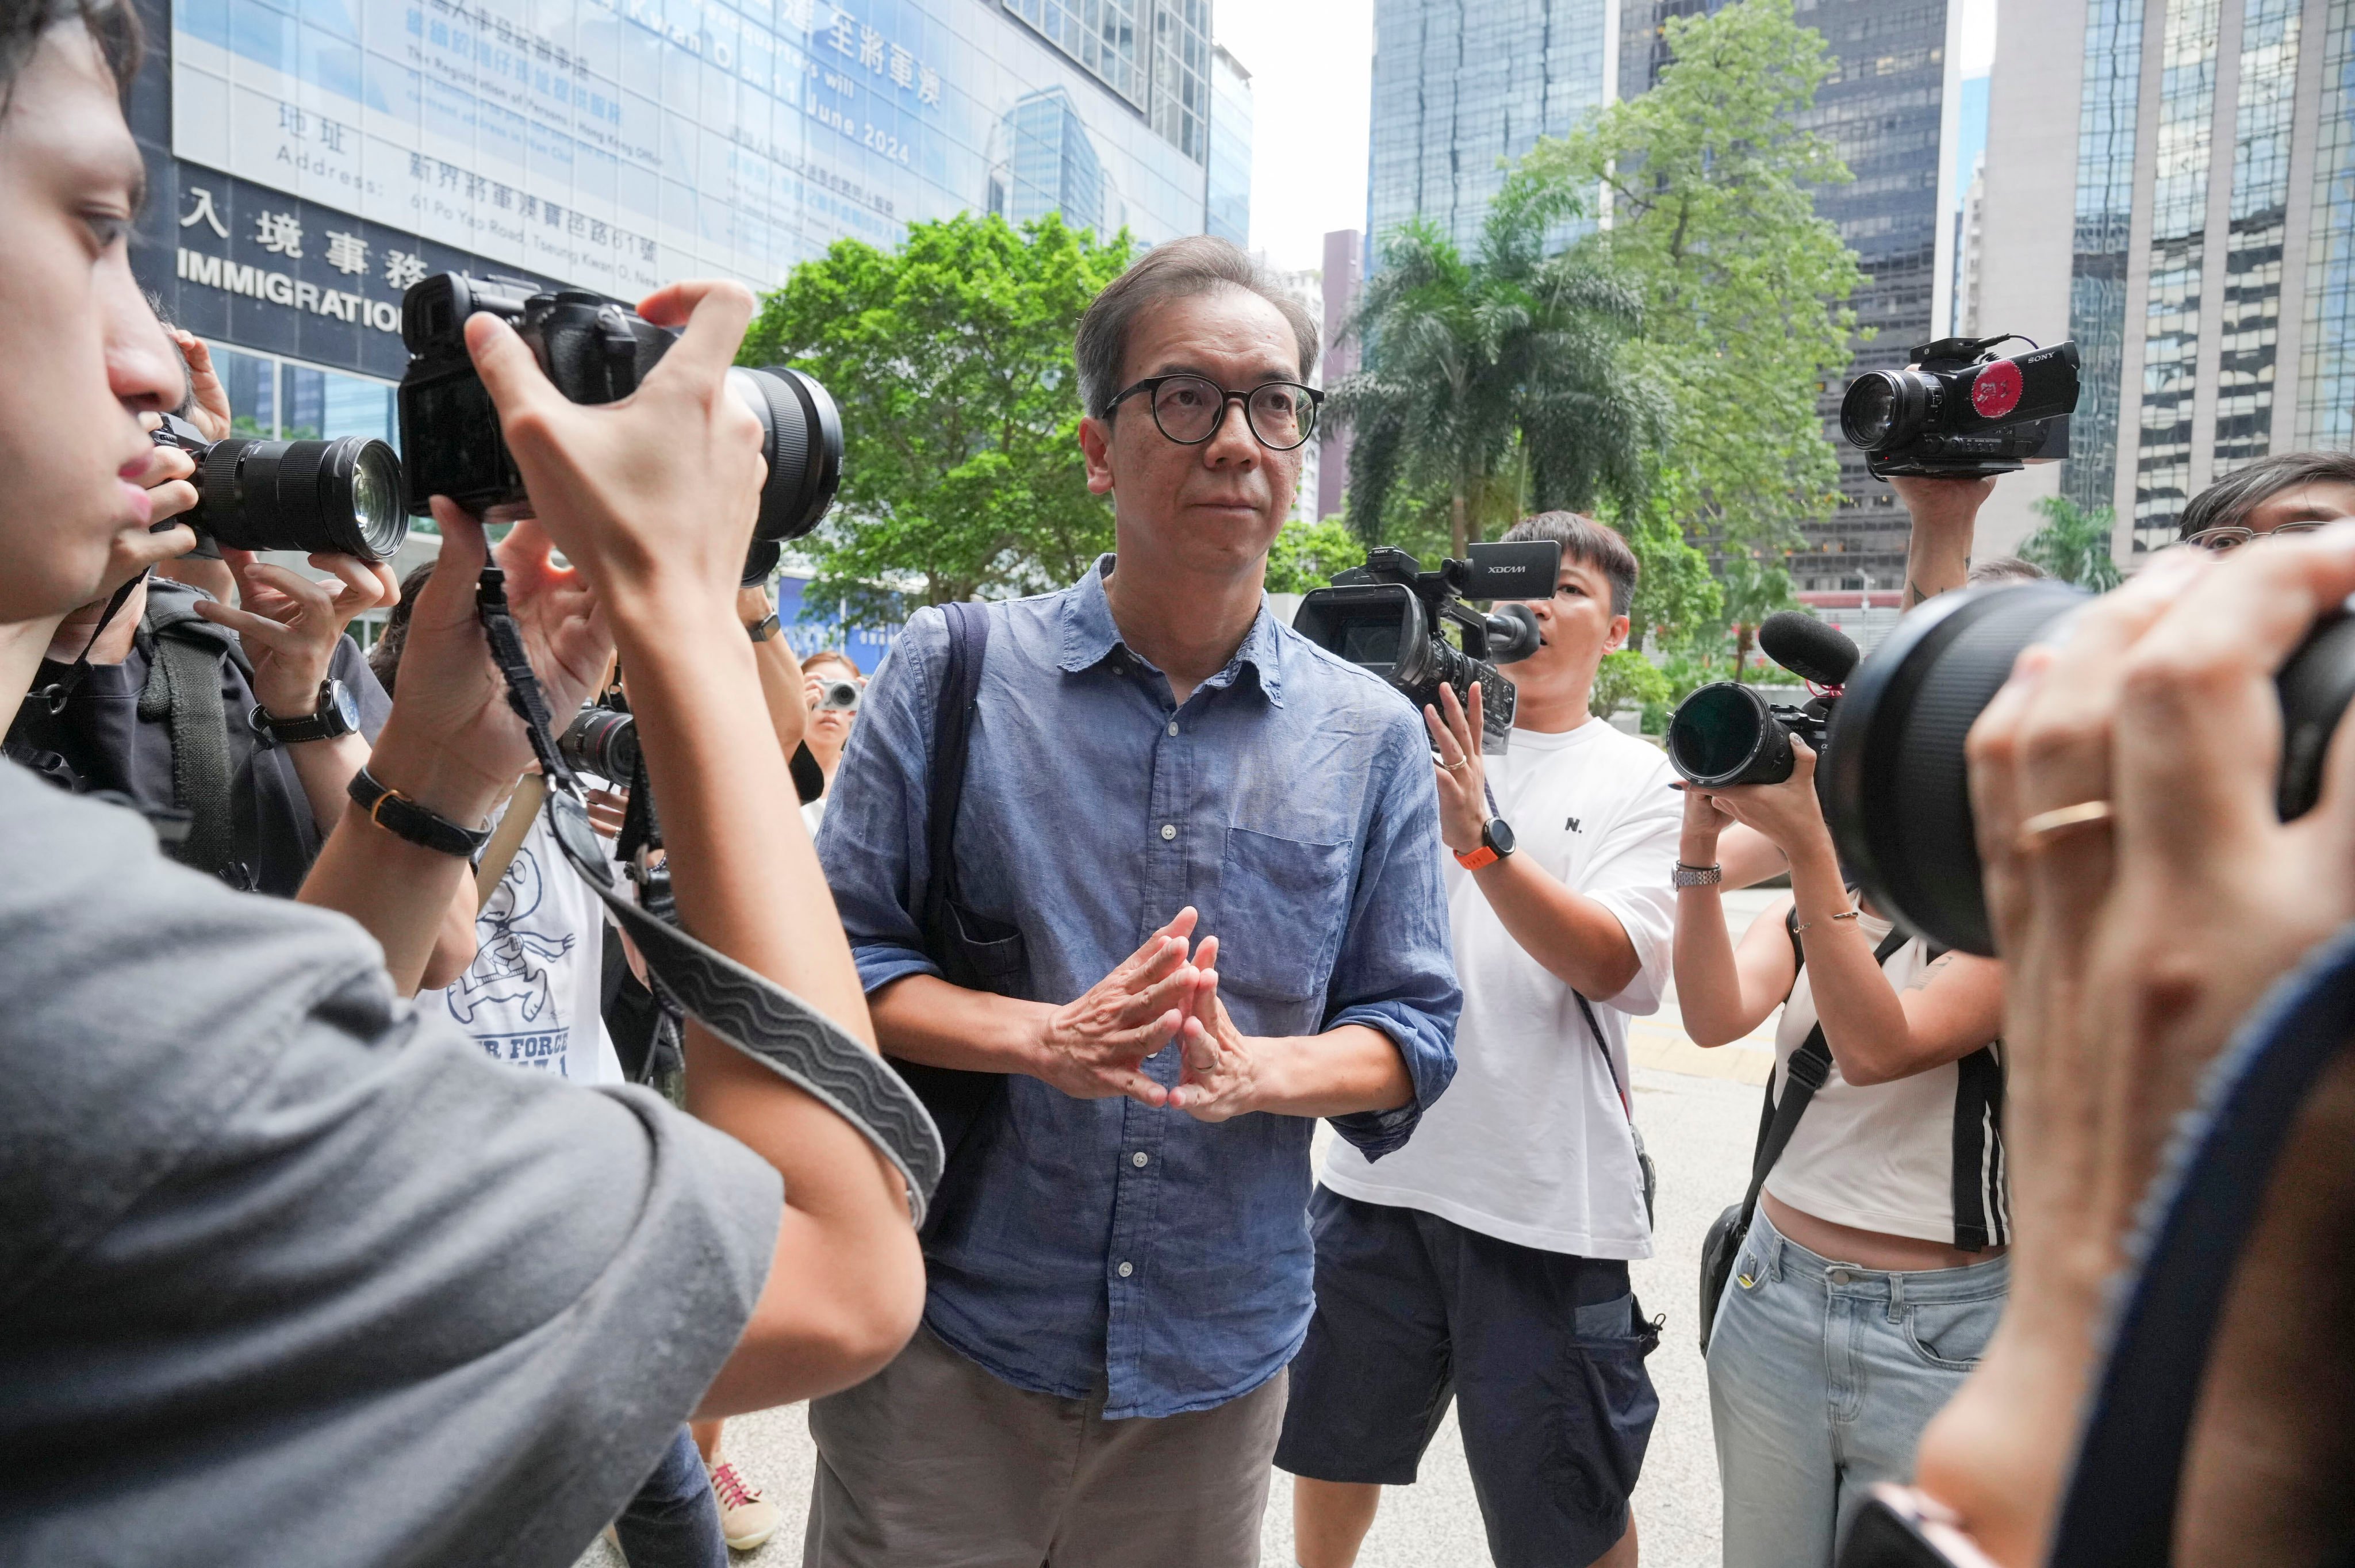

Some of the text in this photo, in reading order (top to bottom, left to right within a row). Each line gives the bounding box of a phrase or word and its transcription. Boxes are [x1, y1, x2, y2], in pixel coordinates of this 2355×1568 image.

[752, 0, 941, 113] 遷至將軍澳
[824, 70, 854, 99] will
[714, 40, 732, 69] O
[806, 92, 854, 137] June
[864, 122, 909, 166] 2024
[278, 101, 344, 155] 地址
[276, 145, 384, 198] Address:
[434, 199, 454, 221] Po
[180, 186, 428, 291] 入境事務
[2027, 351, 2055, 364] SONY
[1487, 566, 1526, 574] XDCAM
[1565, 817, 1582, 834] N.
[509, 1032, 568, 1059] FORCE
